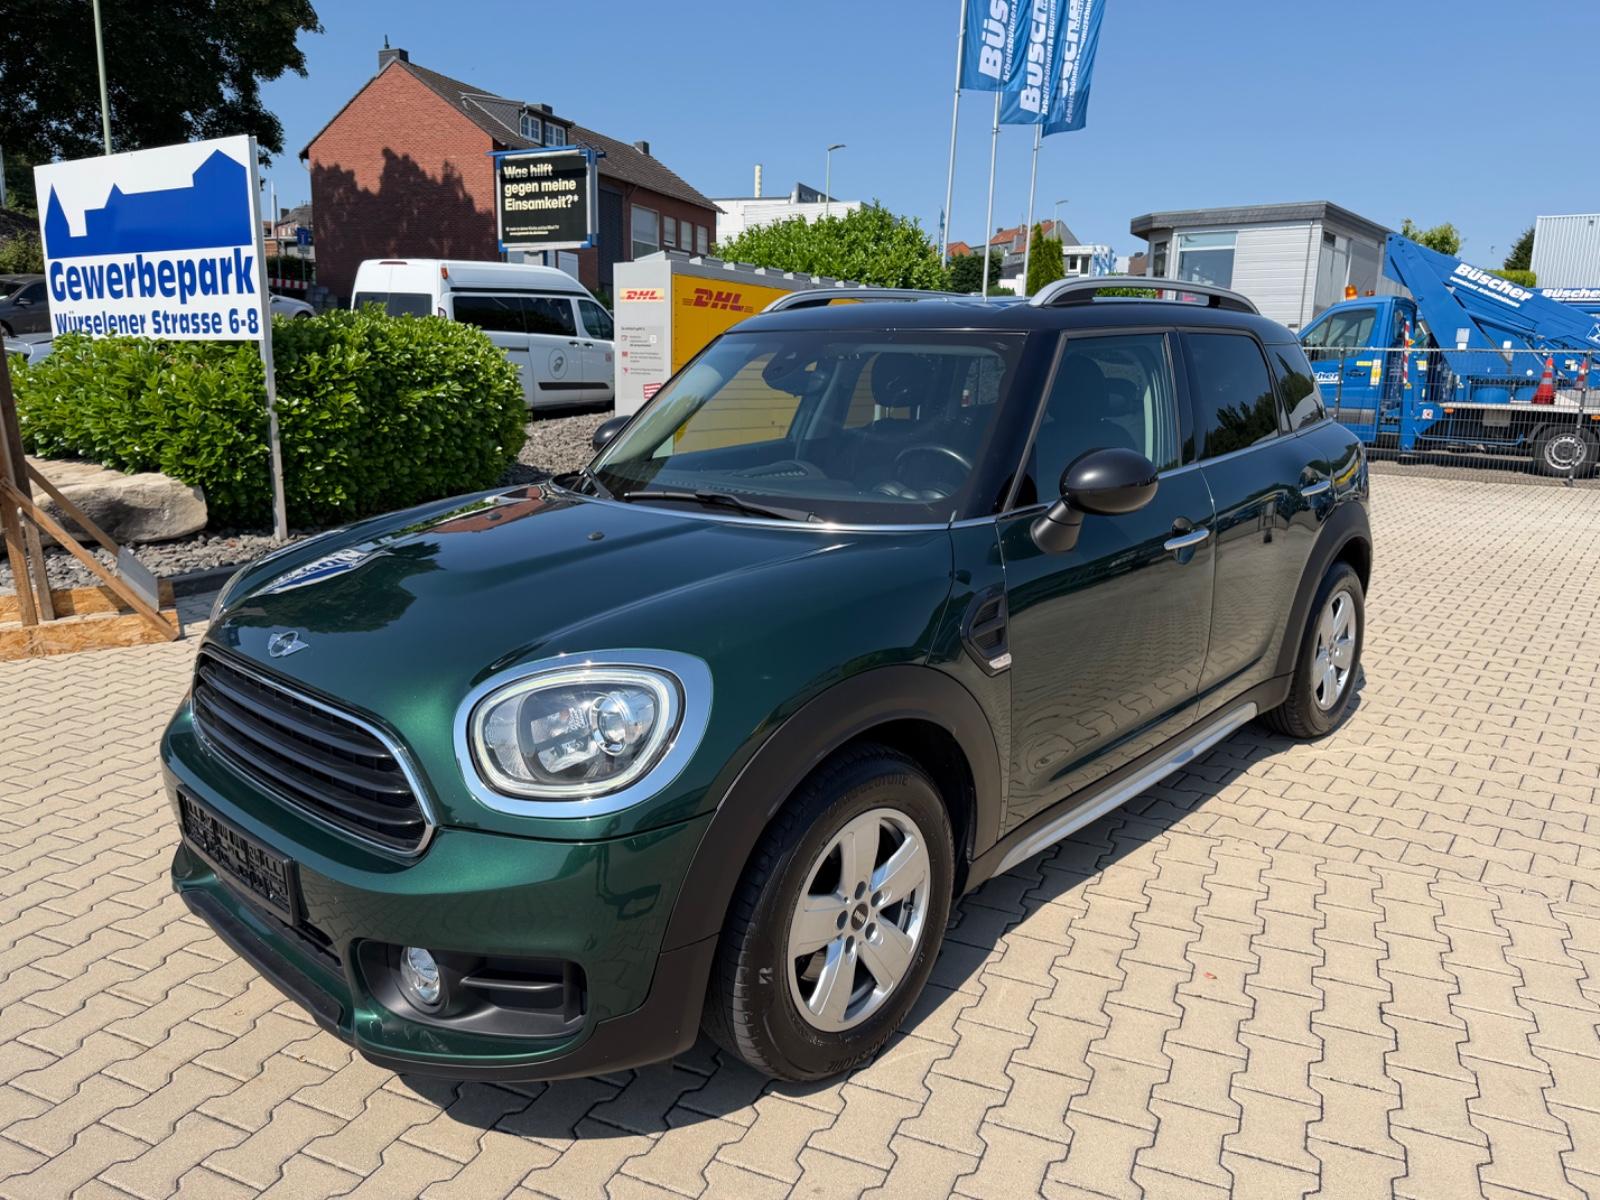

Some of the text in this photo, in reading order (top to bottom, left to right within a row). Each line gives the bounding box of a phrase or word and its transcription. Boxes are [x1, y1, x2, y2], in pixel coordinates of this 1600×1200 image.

[504, 164, 552, 178] Was hilft
[505, 178, 577, 196] gegen meine
[50, 248, 254, 304] Gewerbepark
[1454, 262, 1534, 301] Büscher
[626, 290, 658, 300] DHL
[693, 287, 744, 312] DHL
[55, 307, 259, 335] Würselener Strasse 6-8
